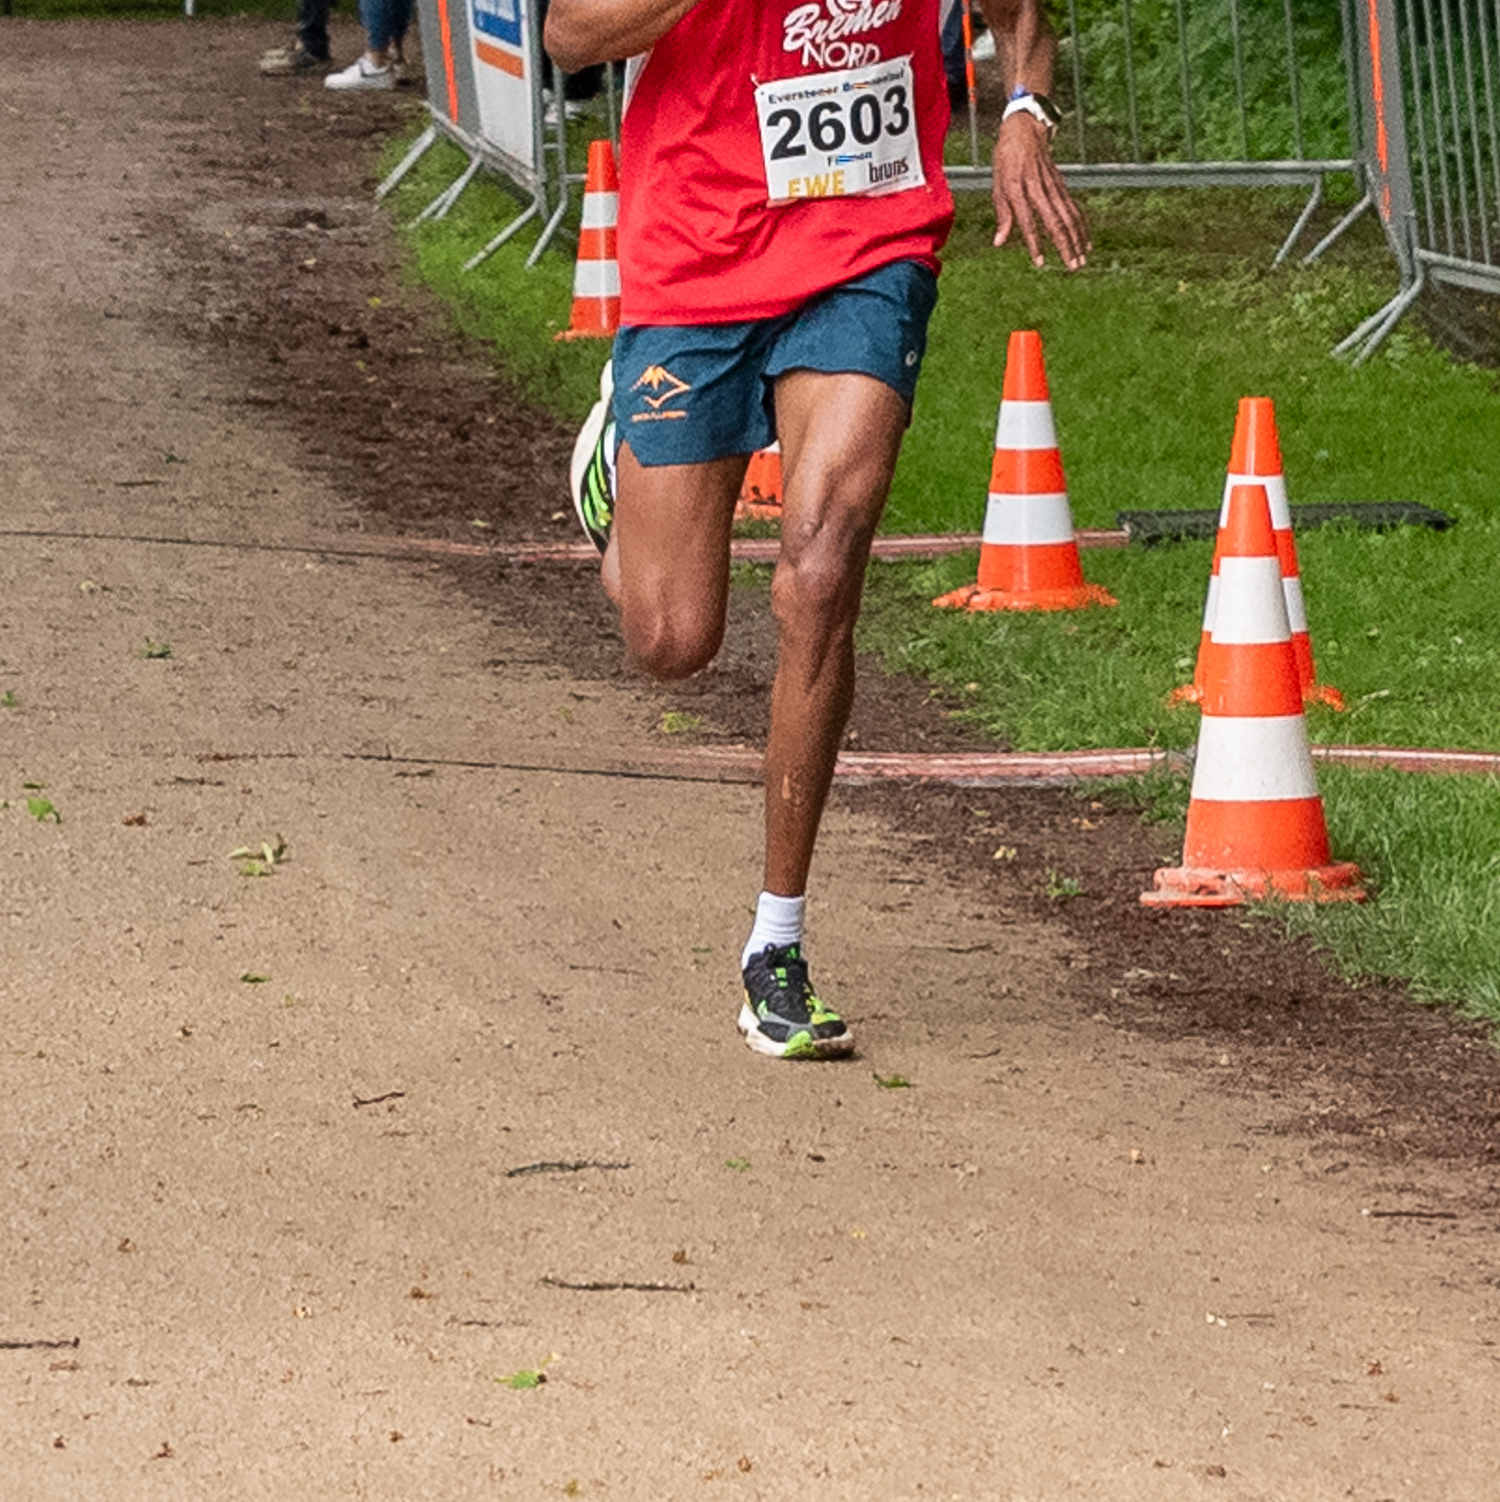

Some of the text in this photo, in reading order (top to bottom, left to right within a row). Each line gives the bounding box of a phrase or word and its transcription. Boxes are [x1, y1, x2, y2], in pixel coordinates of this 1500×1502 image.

[802, 41, 880, 68] NORD
[766, 84, 909, 160] 2603
[869, 157, 909, 183] bruns
[787, 170, 845, 198] EWE
